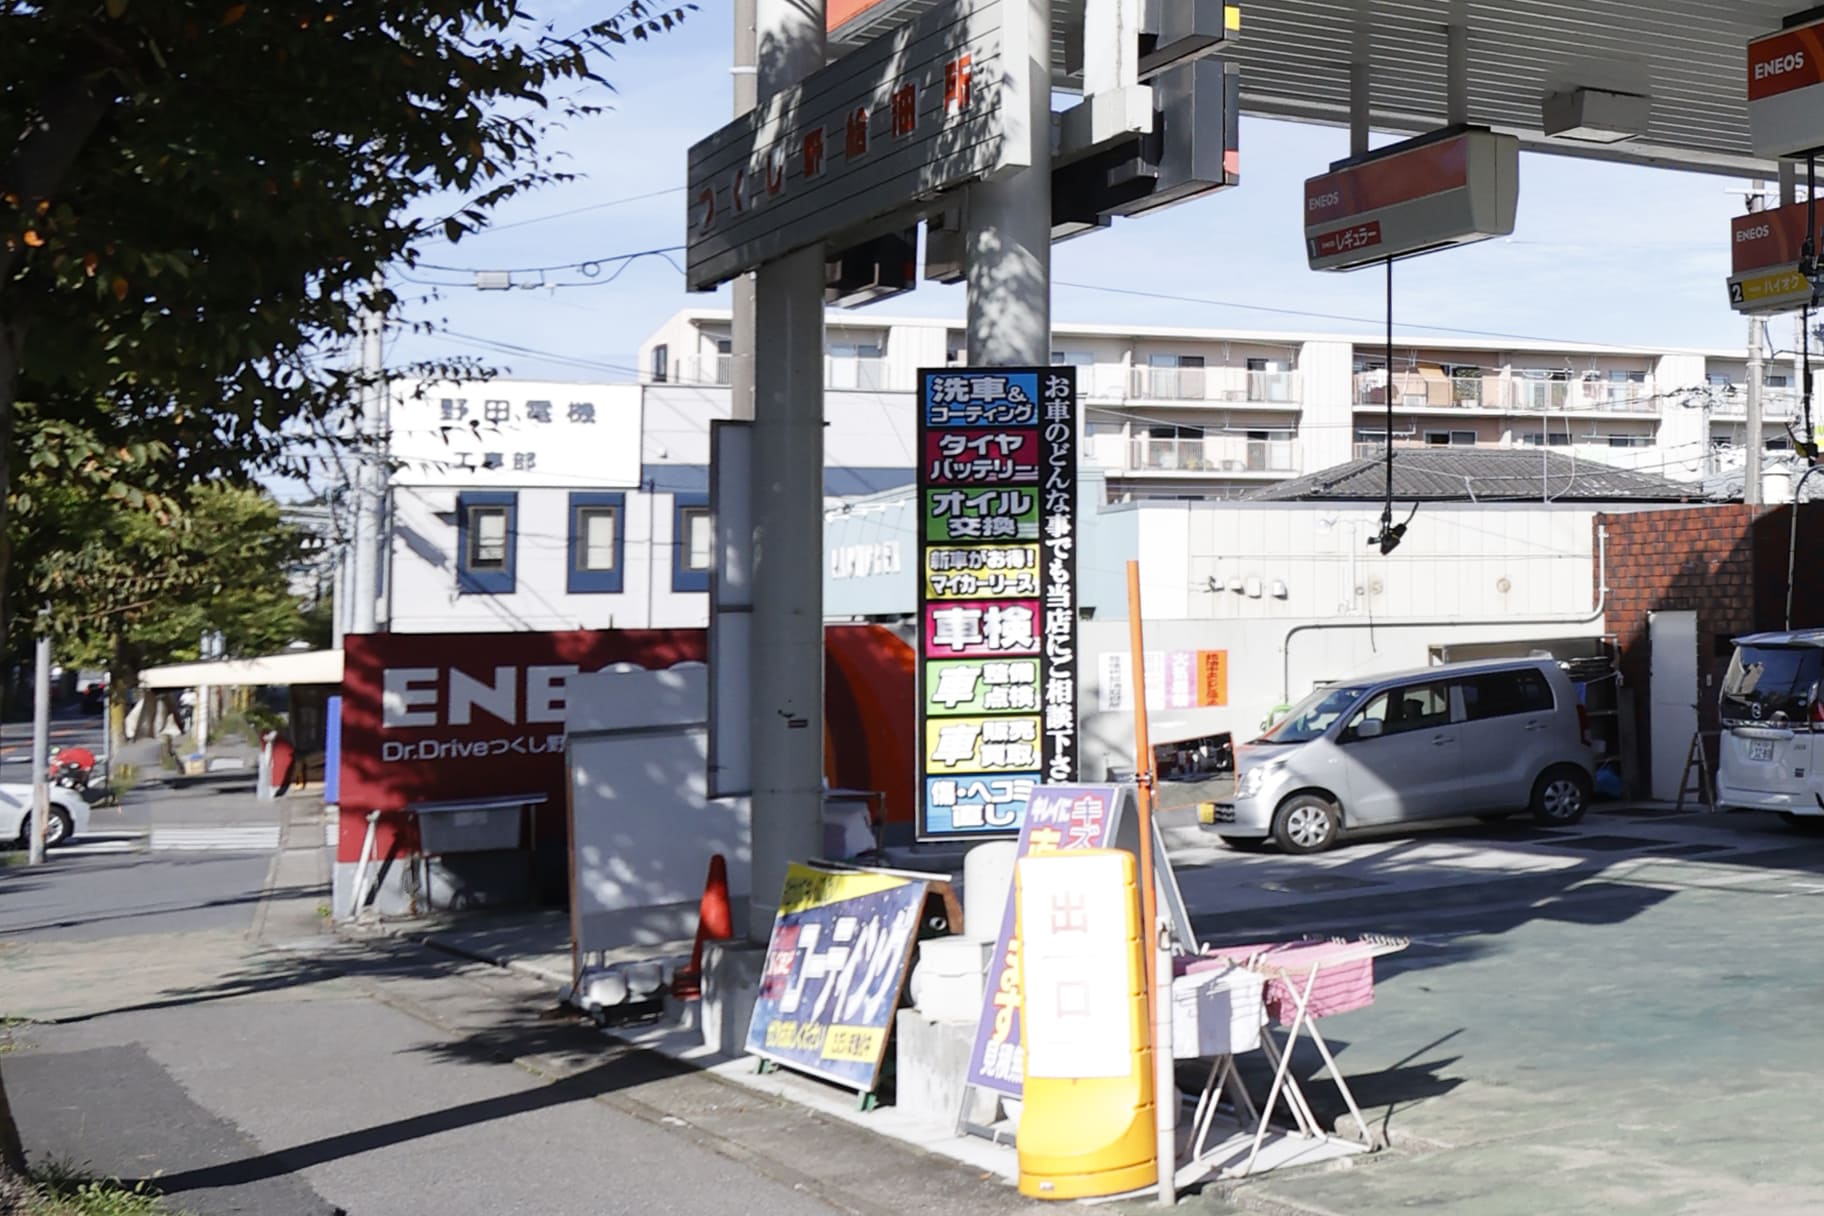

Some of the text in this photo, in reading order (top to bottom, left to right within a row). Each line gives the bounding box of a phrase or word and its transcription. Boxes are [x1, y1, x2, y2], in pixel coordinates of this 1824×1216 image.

[1753, 52, 1805, 81] ENEOS
[1308, 191, 1339, 211] ENEOS
[1335, 227, 1377, 251] レギュラー
[1735, 224, 1770, 243] ENEOS
[1731, 284, 1743, 303] 2
[1763, 274, 1800, 296] ハイオク
[440, 398, 596, 424] 野田電機
[930, 404, 1033, 424] コーティング
[939, 434, 1024, 457] タイヤ
[453, 451, 537, 471] 工事部
[930, 459, 1034, 480] バッテリー
[932, 491, 1032, 517] オイル
[949, 516, 1017, 537] 交換
[930, 573, 1036, 596] マイカーリース
[1044, 374, 1075, 786] お車のどんな事でも当店にご相談下さ
[932, 605, 1034, 652] 車検
[930, 664, 983, 709] 車
[982, 684, 1037, 710] 点検
[981, 719, 1038, 744] 販売
[930, 723, 983, 768] 車
[951, 803, 1017, 828] 直し
[778, 897, 920, 1025] コーティング
